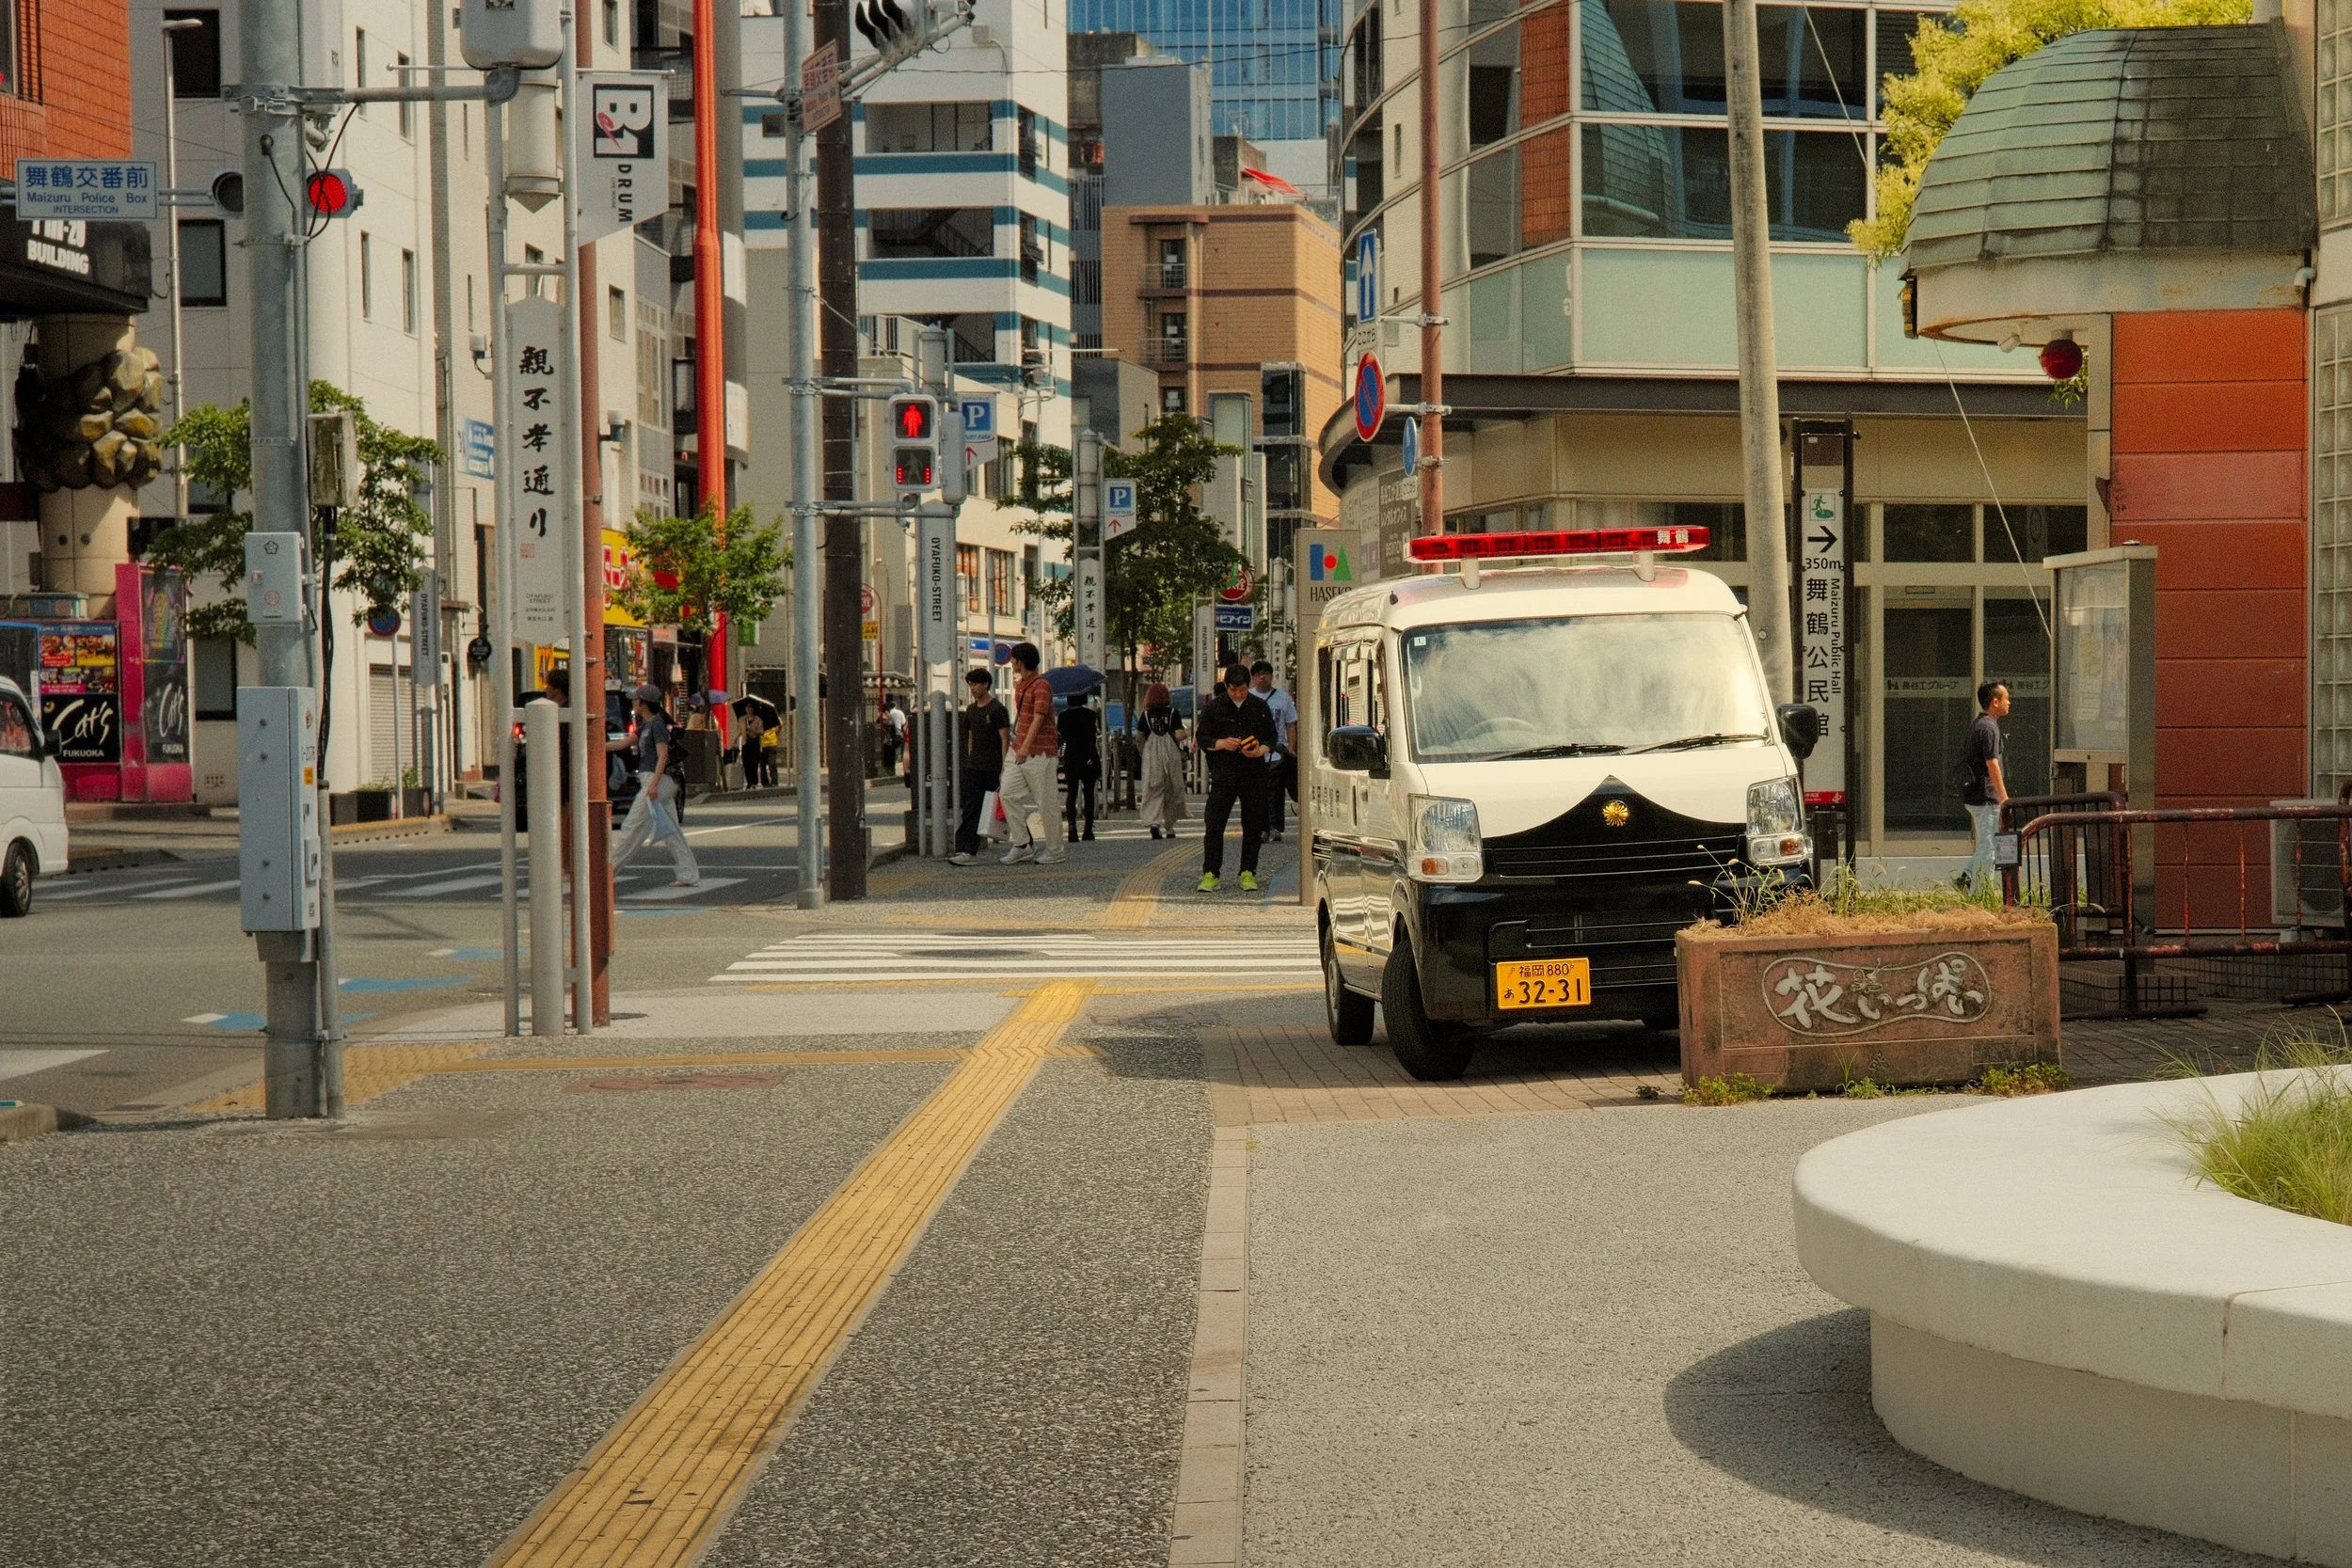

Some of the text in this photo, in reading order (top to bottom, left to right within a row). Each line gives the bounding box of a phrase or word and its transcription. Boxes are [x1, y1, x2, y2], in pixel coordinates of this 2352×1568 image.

[25, 166, 149, 189] 舞鶴交番前
[26, 192, 148, 203] Maizuru Police Box
[617, 164, 632, 222] DRUM
[53, 205, 119, 214] INTERSECTION
[27, 239, 89, 275] BUILDING
[967, 404, 985, 428] P
[518, 345, 555, 538] 親不孝通り
[1114, 488, 1127, 506] P
[1805, 558, 1841, 570] 350m
[931, 537, 942, 623] OYAFUKO-STREET
[1831, 578, 1841, 694] Maizuru Public Hall
[52, 699, 113, 745] Cat's
[159, 683, 183, 737] Cat's
[63, 749, 104, 757] FUKUOKA
[1519, 963, 1569, 977] 福岡 880
[1518, 978, 1581, 1004] 32-31
[1774, 958, 1985, 1029] 花いっぱい
